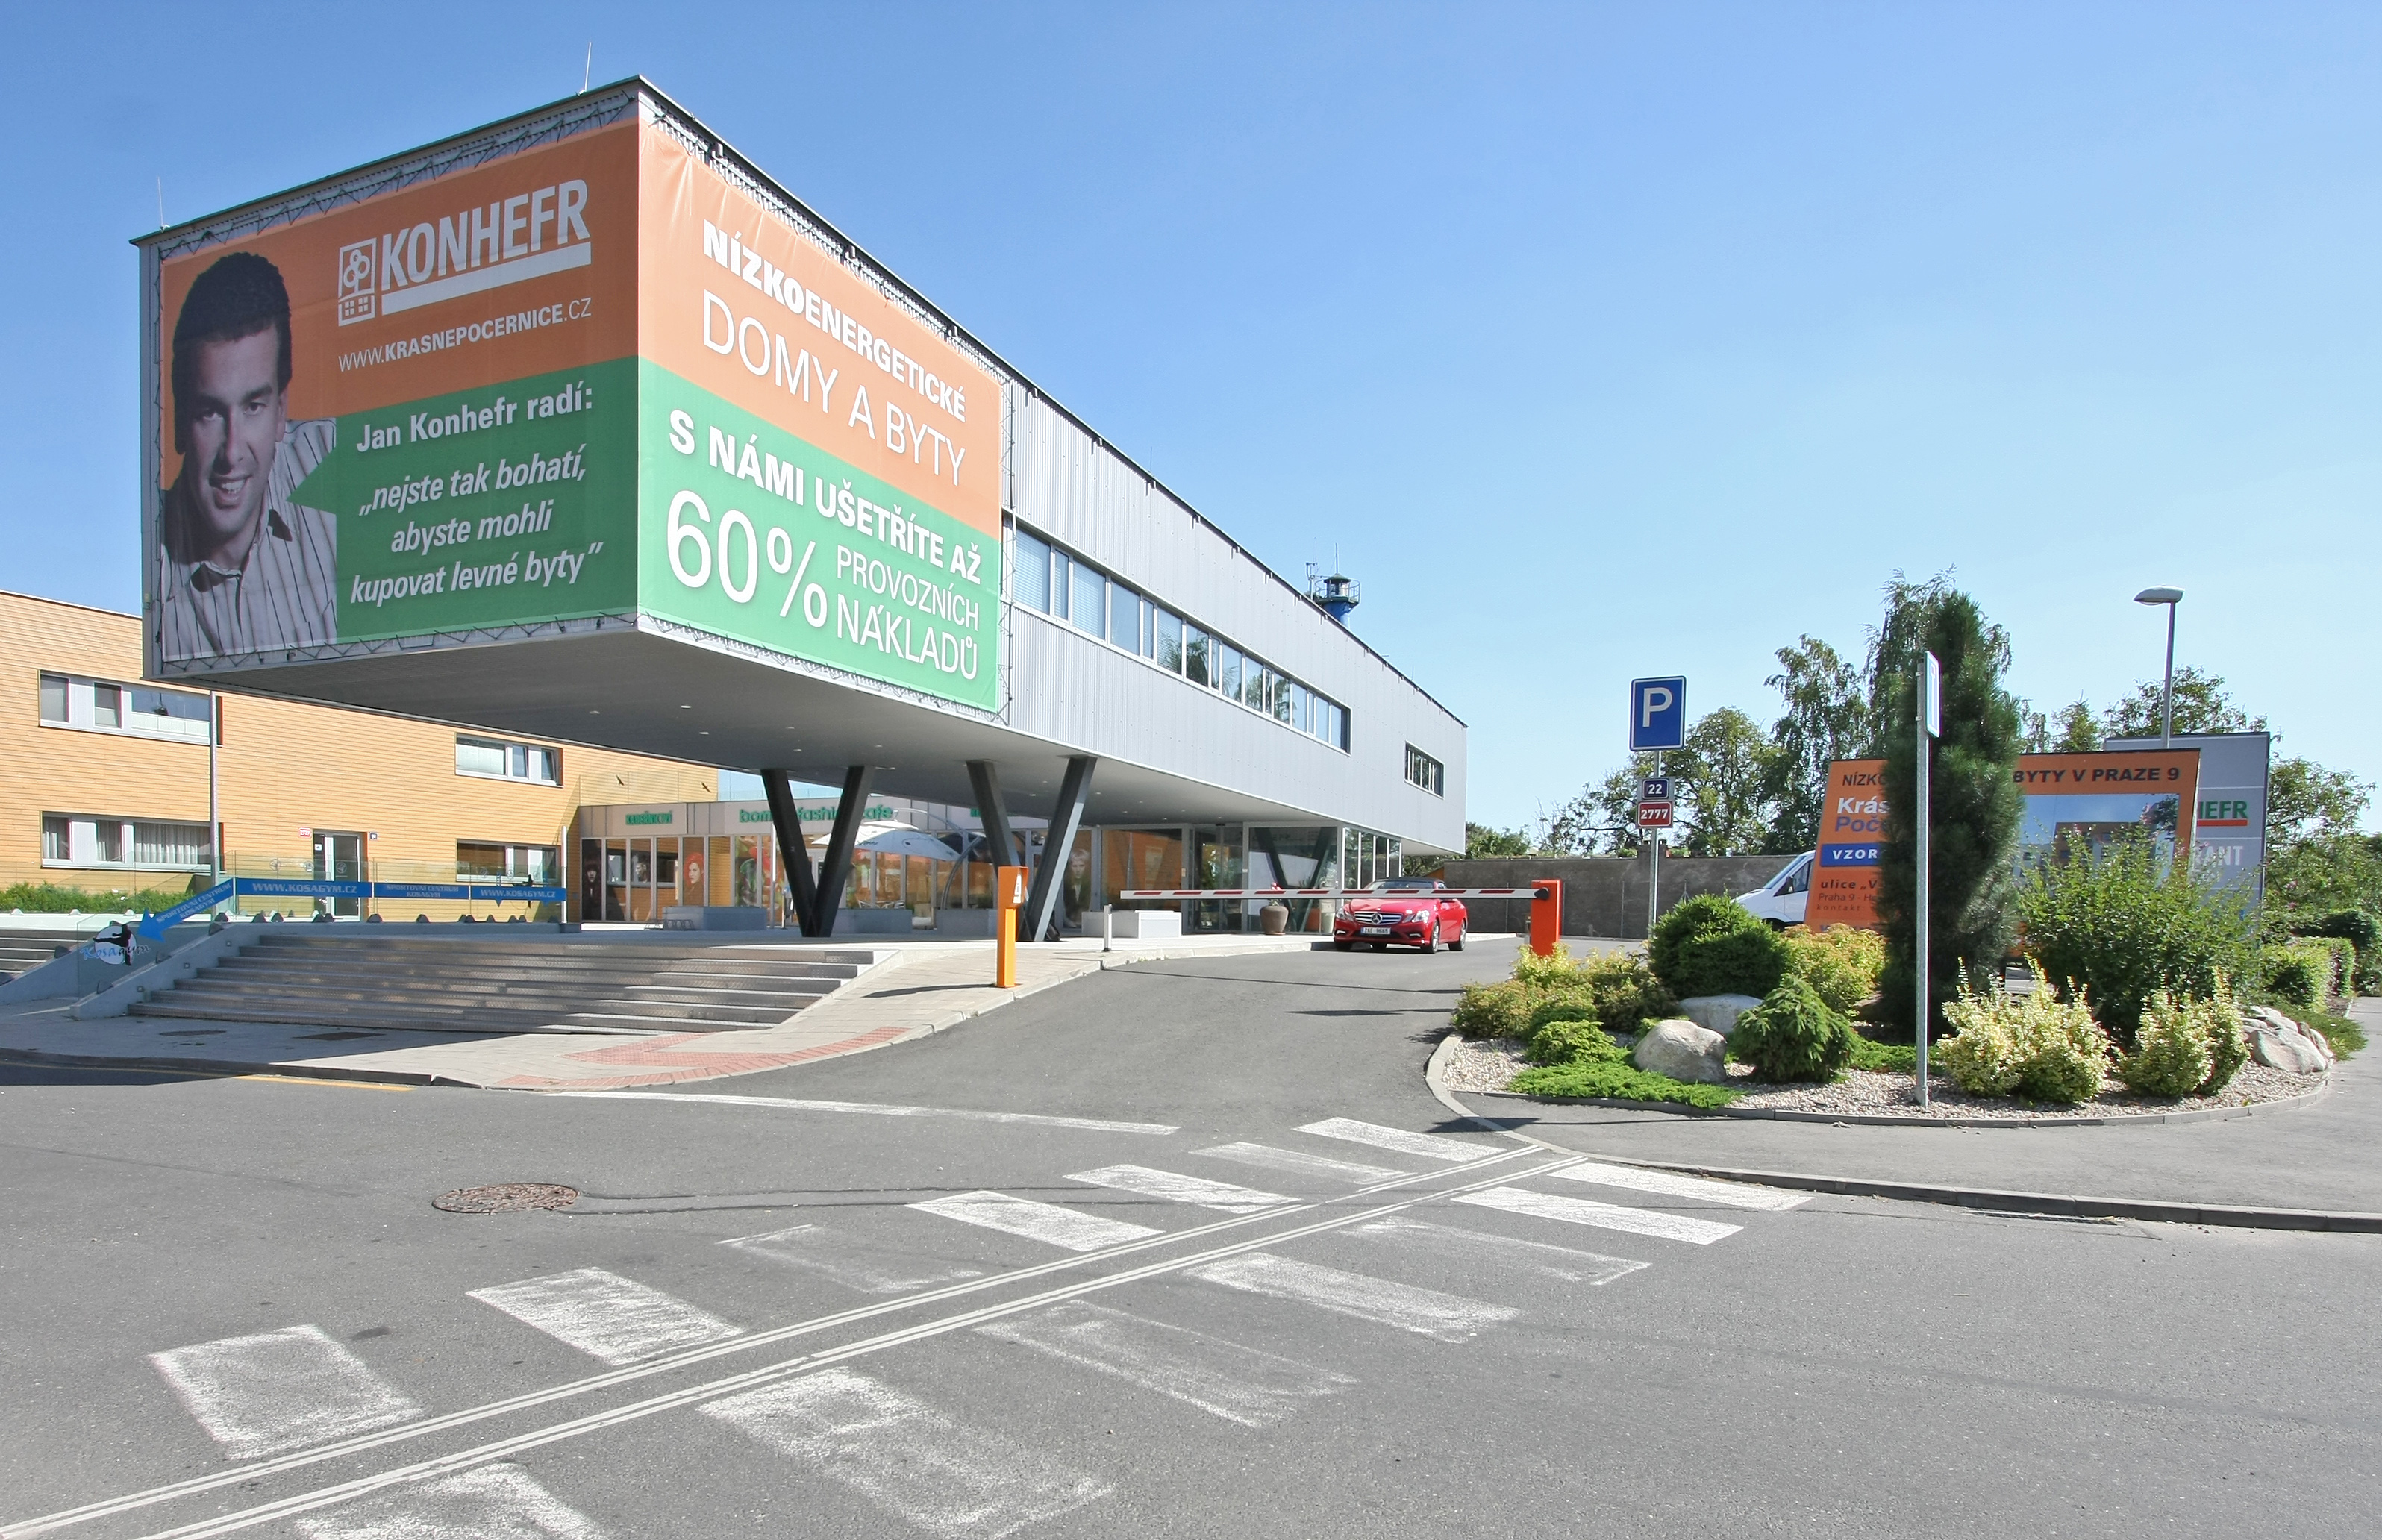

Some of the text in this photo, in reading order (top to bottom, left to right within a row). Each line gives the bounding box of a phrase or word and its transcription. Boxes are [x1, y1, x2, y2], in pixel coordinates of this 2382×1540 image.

[381, 179, 590, 291] KONHEFR
[338, 298, 592, 372] WWW.KRASNEPOCERNICE.CZ
[703, 219, 966, 423] NÍZKOENERGETICKÉ
[703, 288, 966, 486] DOMY A BYTY
[357, 379, 593, 452] Jan Konhefr radí:
[450, 463, 489, 495] tak
[495, 444, 586, 481] bohatí,
[669, 409, 981, 585] S NÁMI UŠETŘÍTE AŽ
[390, 500, 554, 556] abyste mohli
[350, 566, 446, 607] kupovat
[451, 552, 517, 592] levné
[666, 490, 828, 627] 60%
[837, 544, 978, 632] PROVOZNÍCH
[837, 593, 978, 680] NÁKLADŮ
[1642, 687, 1672, 727] P
[1648, 784, 1662, 795] 22
[2013, 769, 2066, 783] BYTY
[2072, 769, 2086, 782] V
[2092, 768, 2160, 782] PRAZE
[2167, 767, 2180, 781] 9
[740, 804, 893, 822] bom fashi afe
[1641, 809, 1669, 820] 2777
[1835, 814, 1884, 832] Poč
[1837, 796, 1890, 814] Krás
[1833, 849, 1878, 860] VZOR
[252, 883, 357, 893] WWW.KOSAGYM.CZ
[481, 889, 556, 898] WWW.KOSAGYM.CZ
[1819, 892, 1845, 901] Praha
[1821, 879, 1856, 889] ulice
